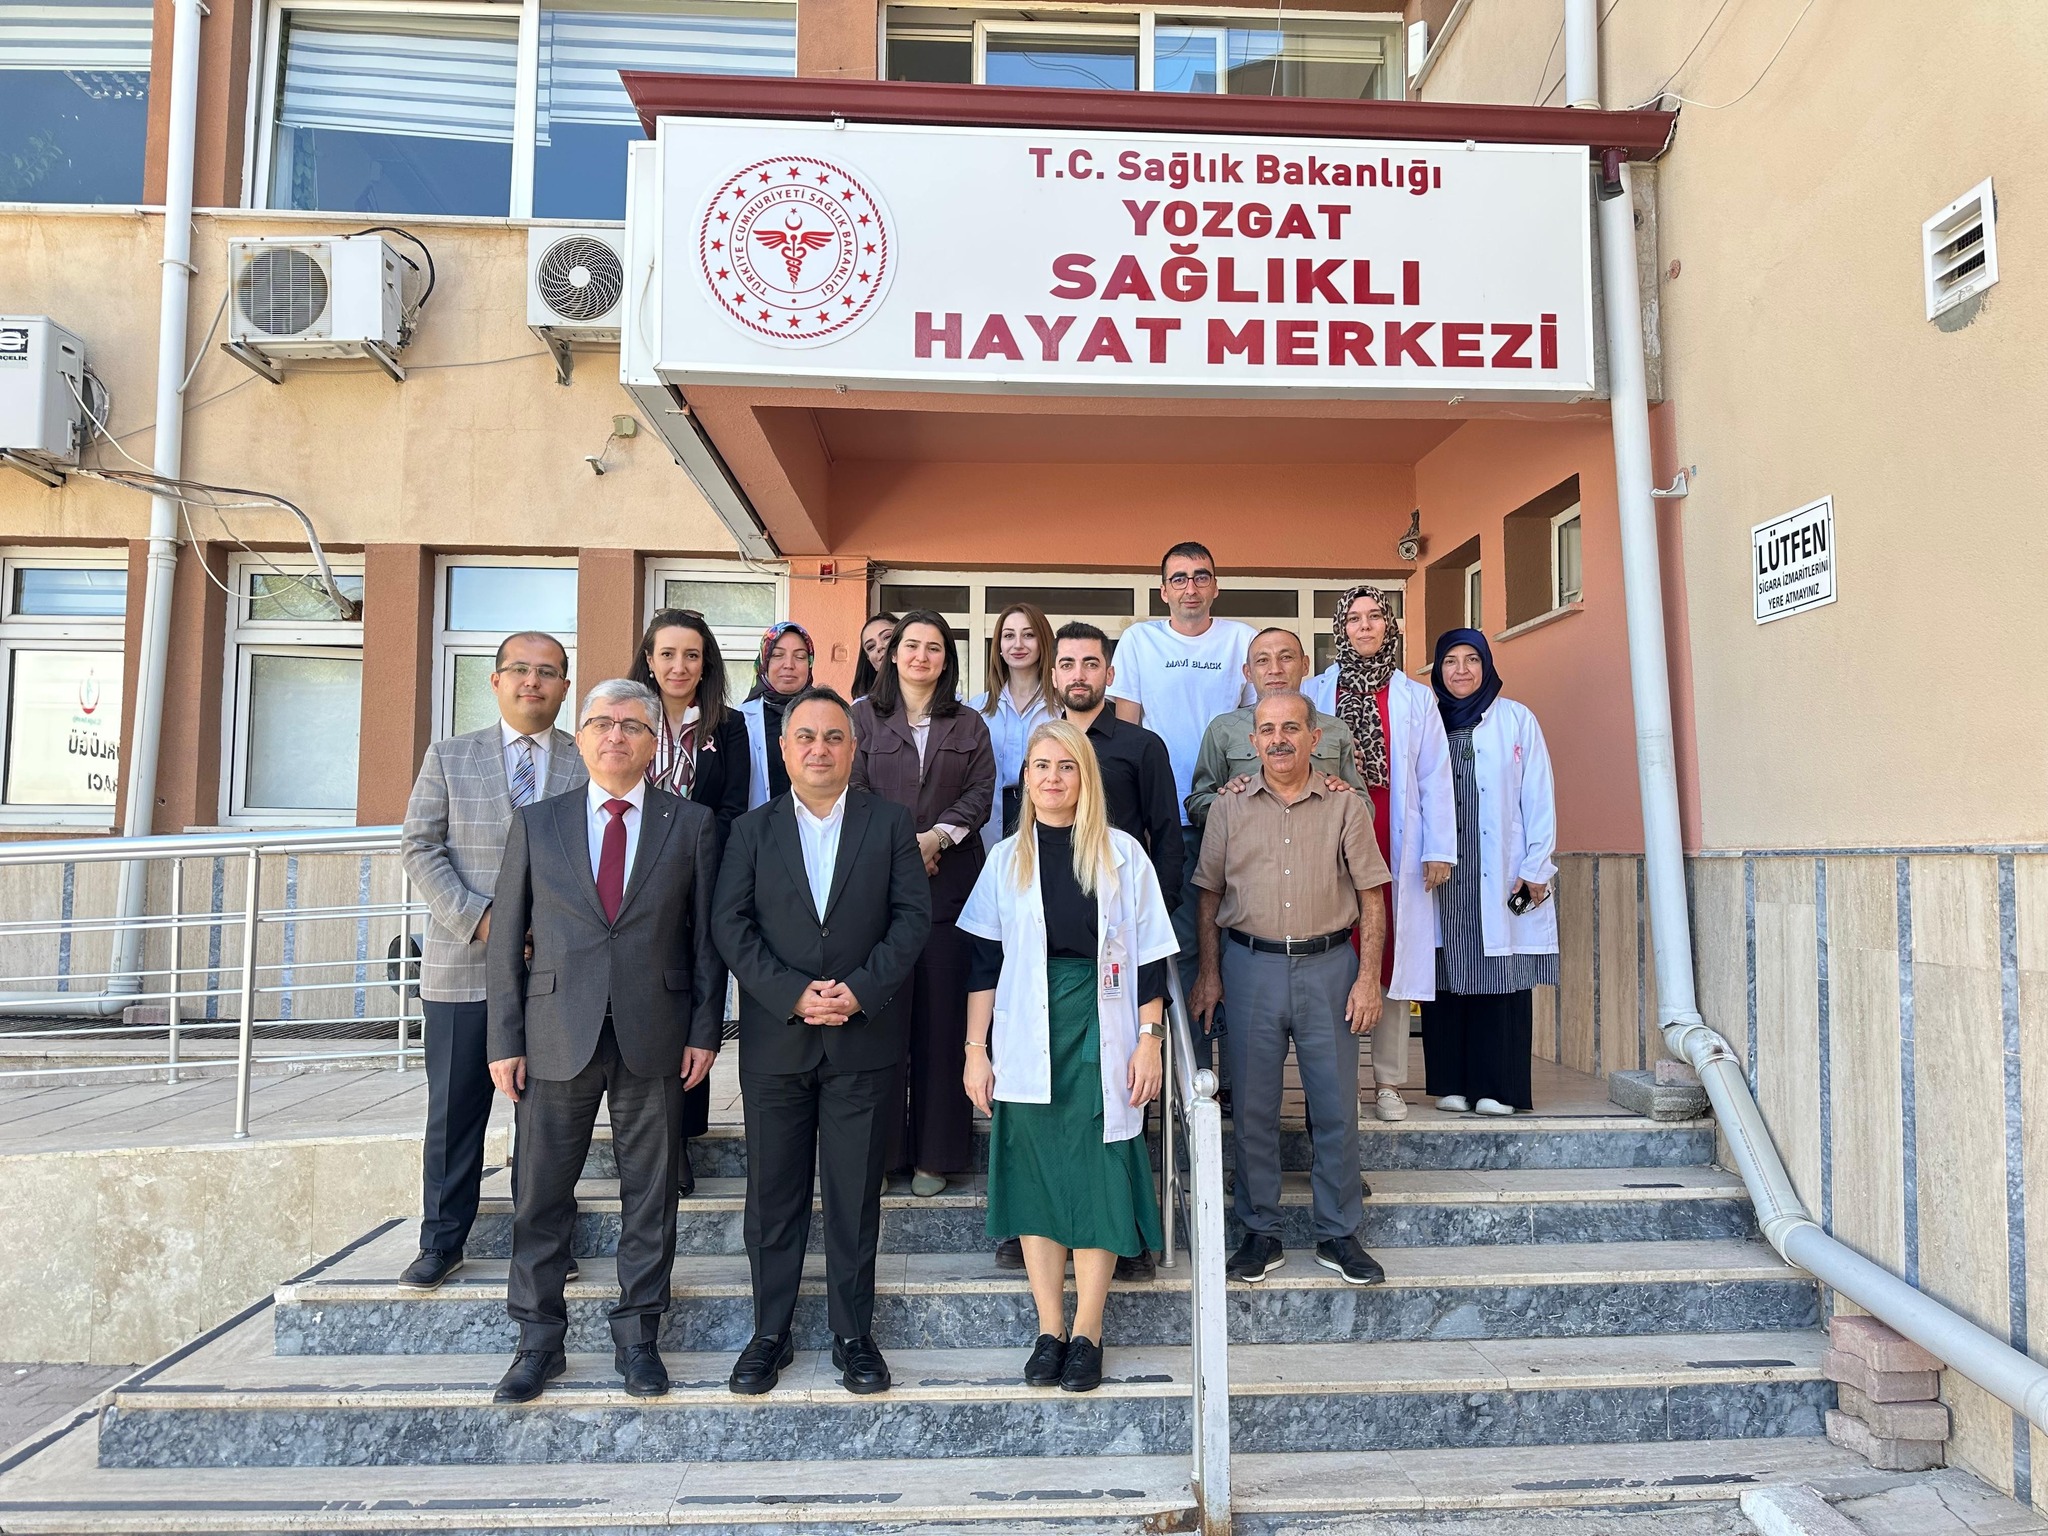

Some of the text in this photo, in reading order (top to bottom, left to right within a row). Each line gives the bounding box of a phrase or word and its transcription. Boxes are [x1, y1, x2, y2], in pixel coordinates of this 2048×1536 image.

[1029, 148, 1441, 196] T.C. Sağlık Bakanlığı
[734, 188, 853, 296] TÜRKİYE CUMHURİYETİ SAĞLIK BAKANLIĞI
[1123, 200, 1351, 240] YOZGAT
[1051, 243, 1420, 306] SAĞLIKLI
[916, 312, 1558, 369] HAYAT MERKEZİ
[1758, 519, 1826, 575] LÜTFEN
[1758, 555, 1829, 595] SİGARA İZMARİTLERİNİ
[1768, 582, 1820, 610] YERE ATMAYINIZ
[1165, 658, 1222, 670] MAVİ BLACK
